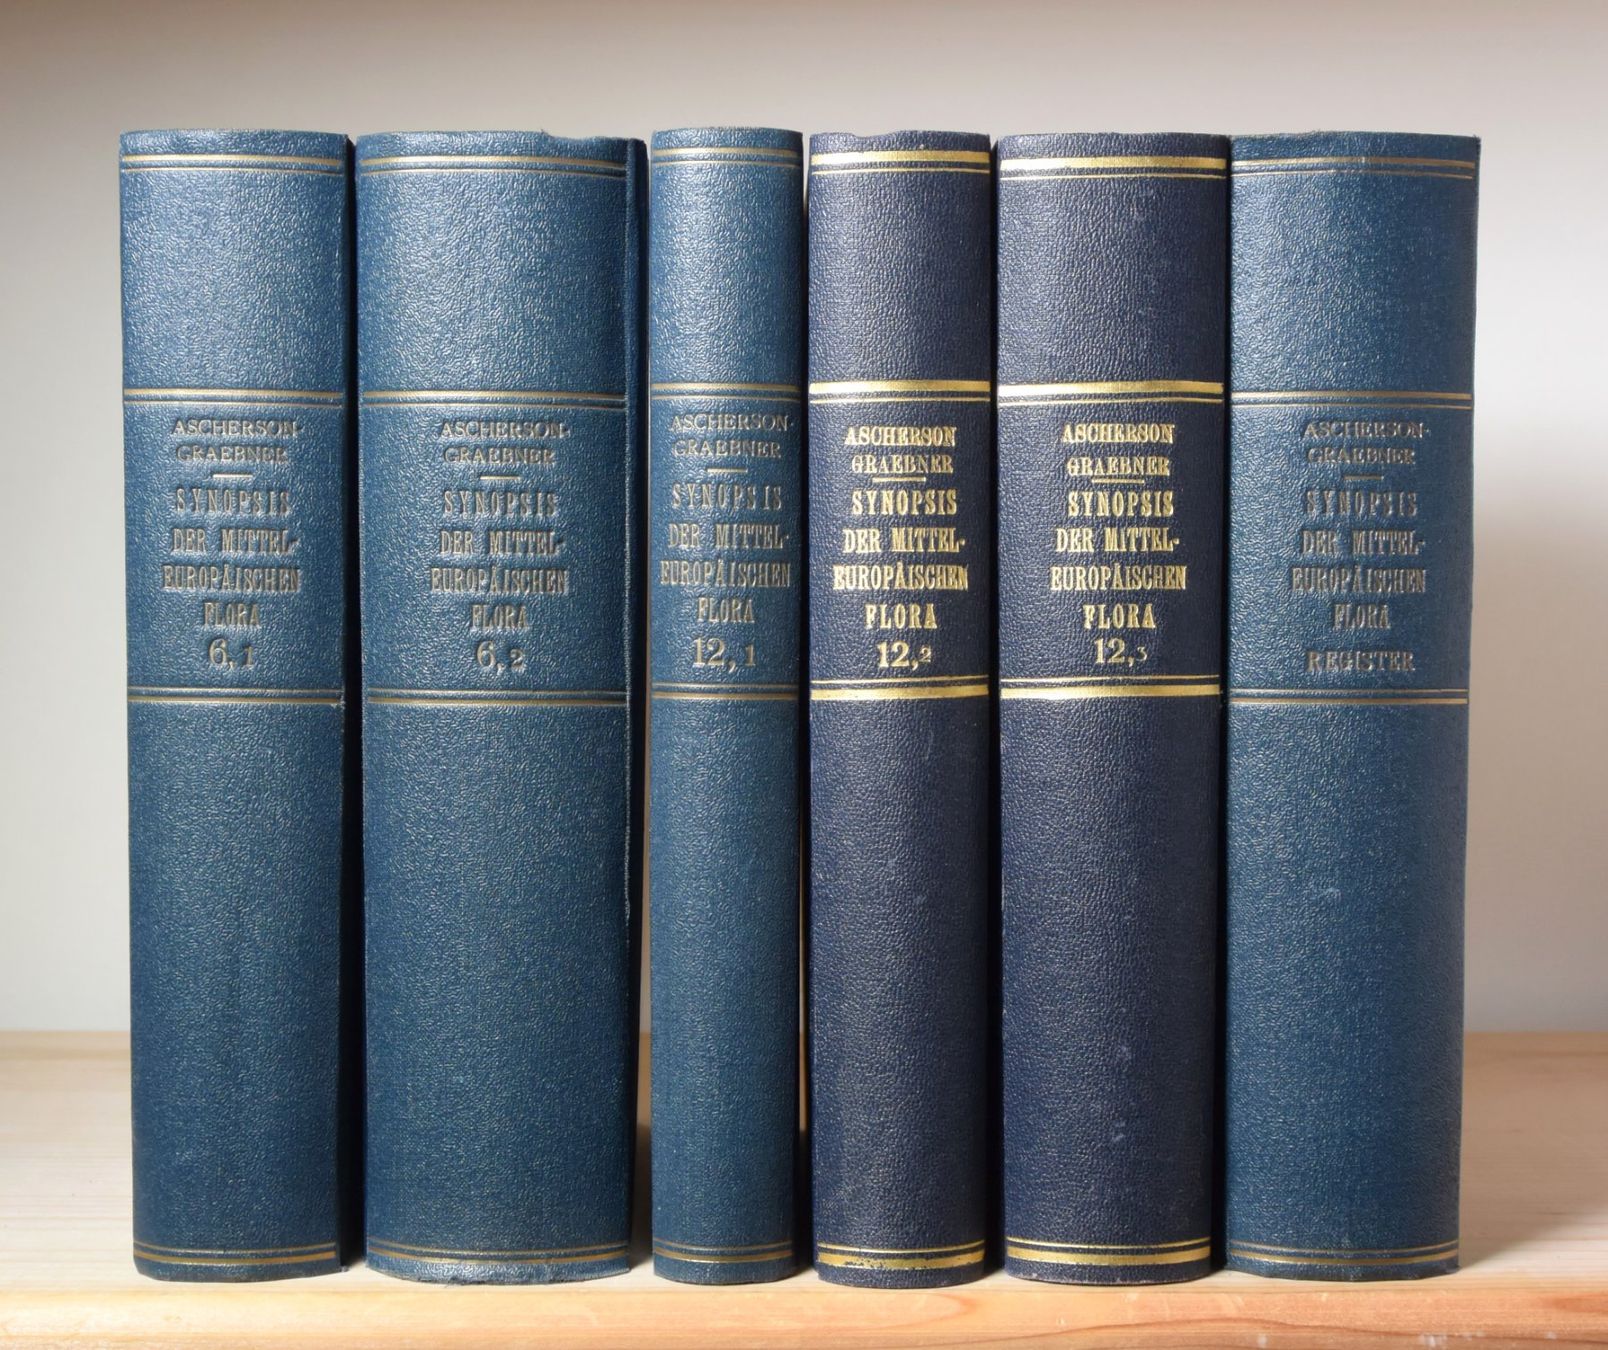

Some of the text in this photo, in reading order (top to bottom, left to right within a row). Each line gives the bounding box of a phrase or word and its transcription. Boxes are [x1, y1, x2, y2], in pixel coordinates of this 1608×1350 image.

[844, 426, 957, 447] ASCHERSON
[1062, 423, 1175, 443] ASCHERSON
[176, 446, 289, 464] GRAEBNER
[444, 448, 556, 465] GRAEBNER
[673, 440, 782, 458] GRAEBNER
[1307, 448, 1415, 465] GRAEBNER
[852, 455, 954, 474] GRAEBNER
[1067, 457, 1170, 476] GRAEBNER
[176, 488, 290, 515] SYNOPSIS
[443, 491, 557, 516] SYNOPSIS
[672, 483, 782, 511] SYNOPSIS
[852, 489, 957, 515] SYNOPSIS
[1067, 491, 1174, 517] SYNOPSIS
[1306, 491, 1418, 516] SYNOPSIS
[171, 528, 299, 555] DER MITTEL-
[440, 530, 567, 556] DER MITTEL-
[668, 524, 789, 549] DER MITTEL-
[842, 528, 966, 552] DER MITTEL-
[1056, 528, 1180, 552] DER MITTEL-
[1302, 530, 1426, 555] DER MITTEL-
[161, 564, 300, 592] EUROPÄISCHEN
[431, 566, 569, 593] EUROPÄISCHEN
[660, 559, 791, 587] EUROPÄISCHEN
[832, 562, 968, 590] EUROPÄISCHEN
[1051, 562, 1187, 590] EUROPÄISCHEN
[1292, 566, 1426, 593] EUROPÄISCHEN
[203, 601, 260, 627] FLORA
[470, 604, 528, 629] FLORA
[697, 598, 755, 623] FLORA
[864, 604, 938, 629] FLORA
[1083, 604, 1156, 629] FLORA
[1333, 604, 1391, 630] FLORA
[1307, 651, 1415, 672] REGISTER
